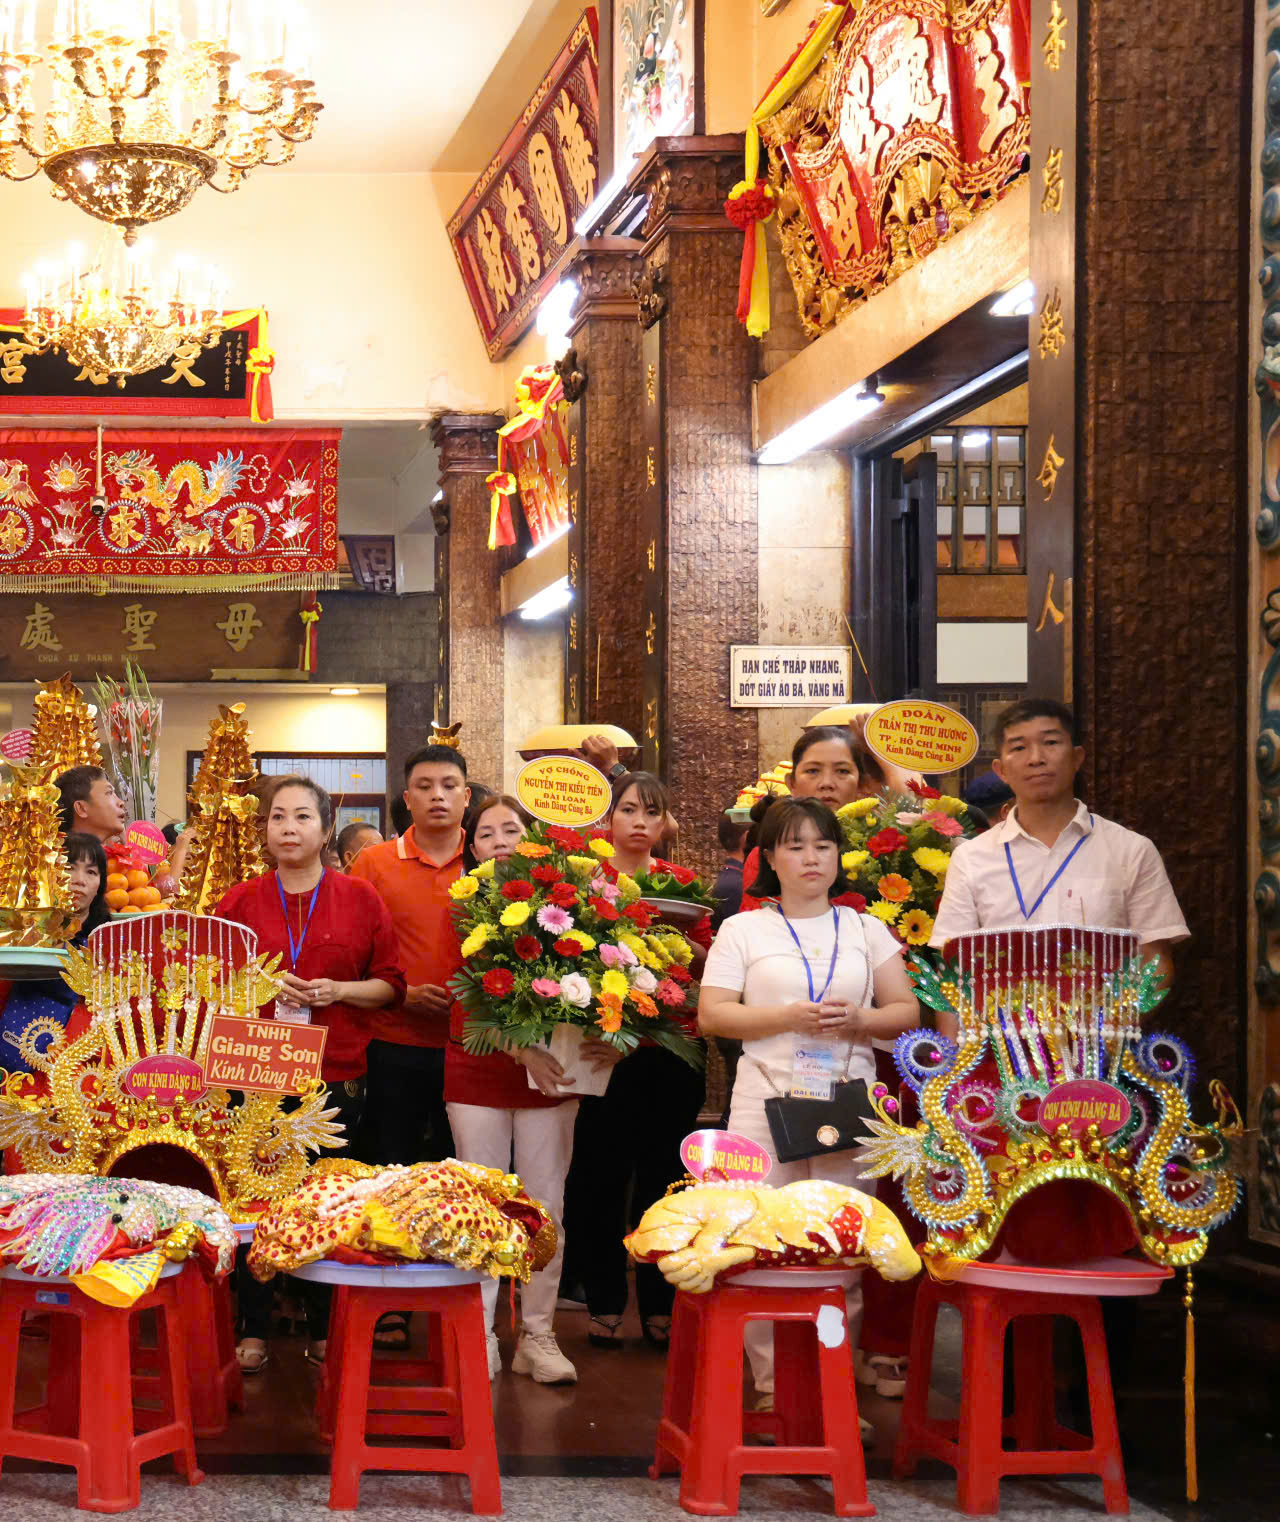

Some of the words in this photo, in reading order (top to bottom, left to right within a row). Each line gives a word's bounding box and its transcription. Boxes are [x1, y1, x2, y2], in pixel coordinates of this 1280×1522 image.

[809, 660, 842, 675] NHANG,
[920, 725, 936, 736] THU
[935, 743, 962, 753] MINH
[562, 796, 586, 804] LOAN
[246, 1023, 291, 1041] TNHH
[211, 1035, 273, 1063] Giang
[278, 1043, 318, 1064] Sơn
[132, 1072, 148, 1087] CON
[210, 1058, 245, 1081] Kính
[248, 1063, 288, 1090] Dâng
[1043, 1102, 1059, 1120] CON
